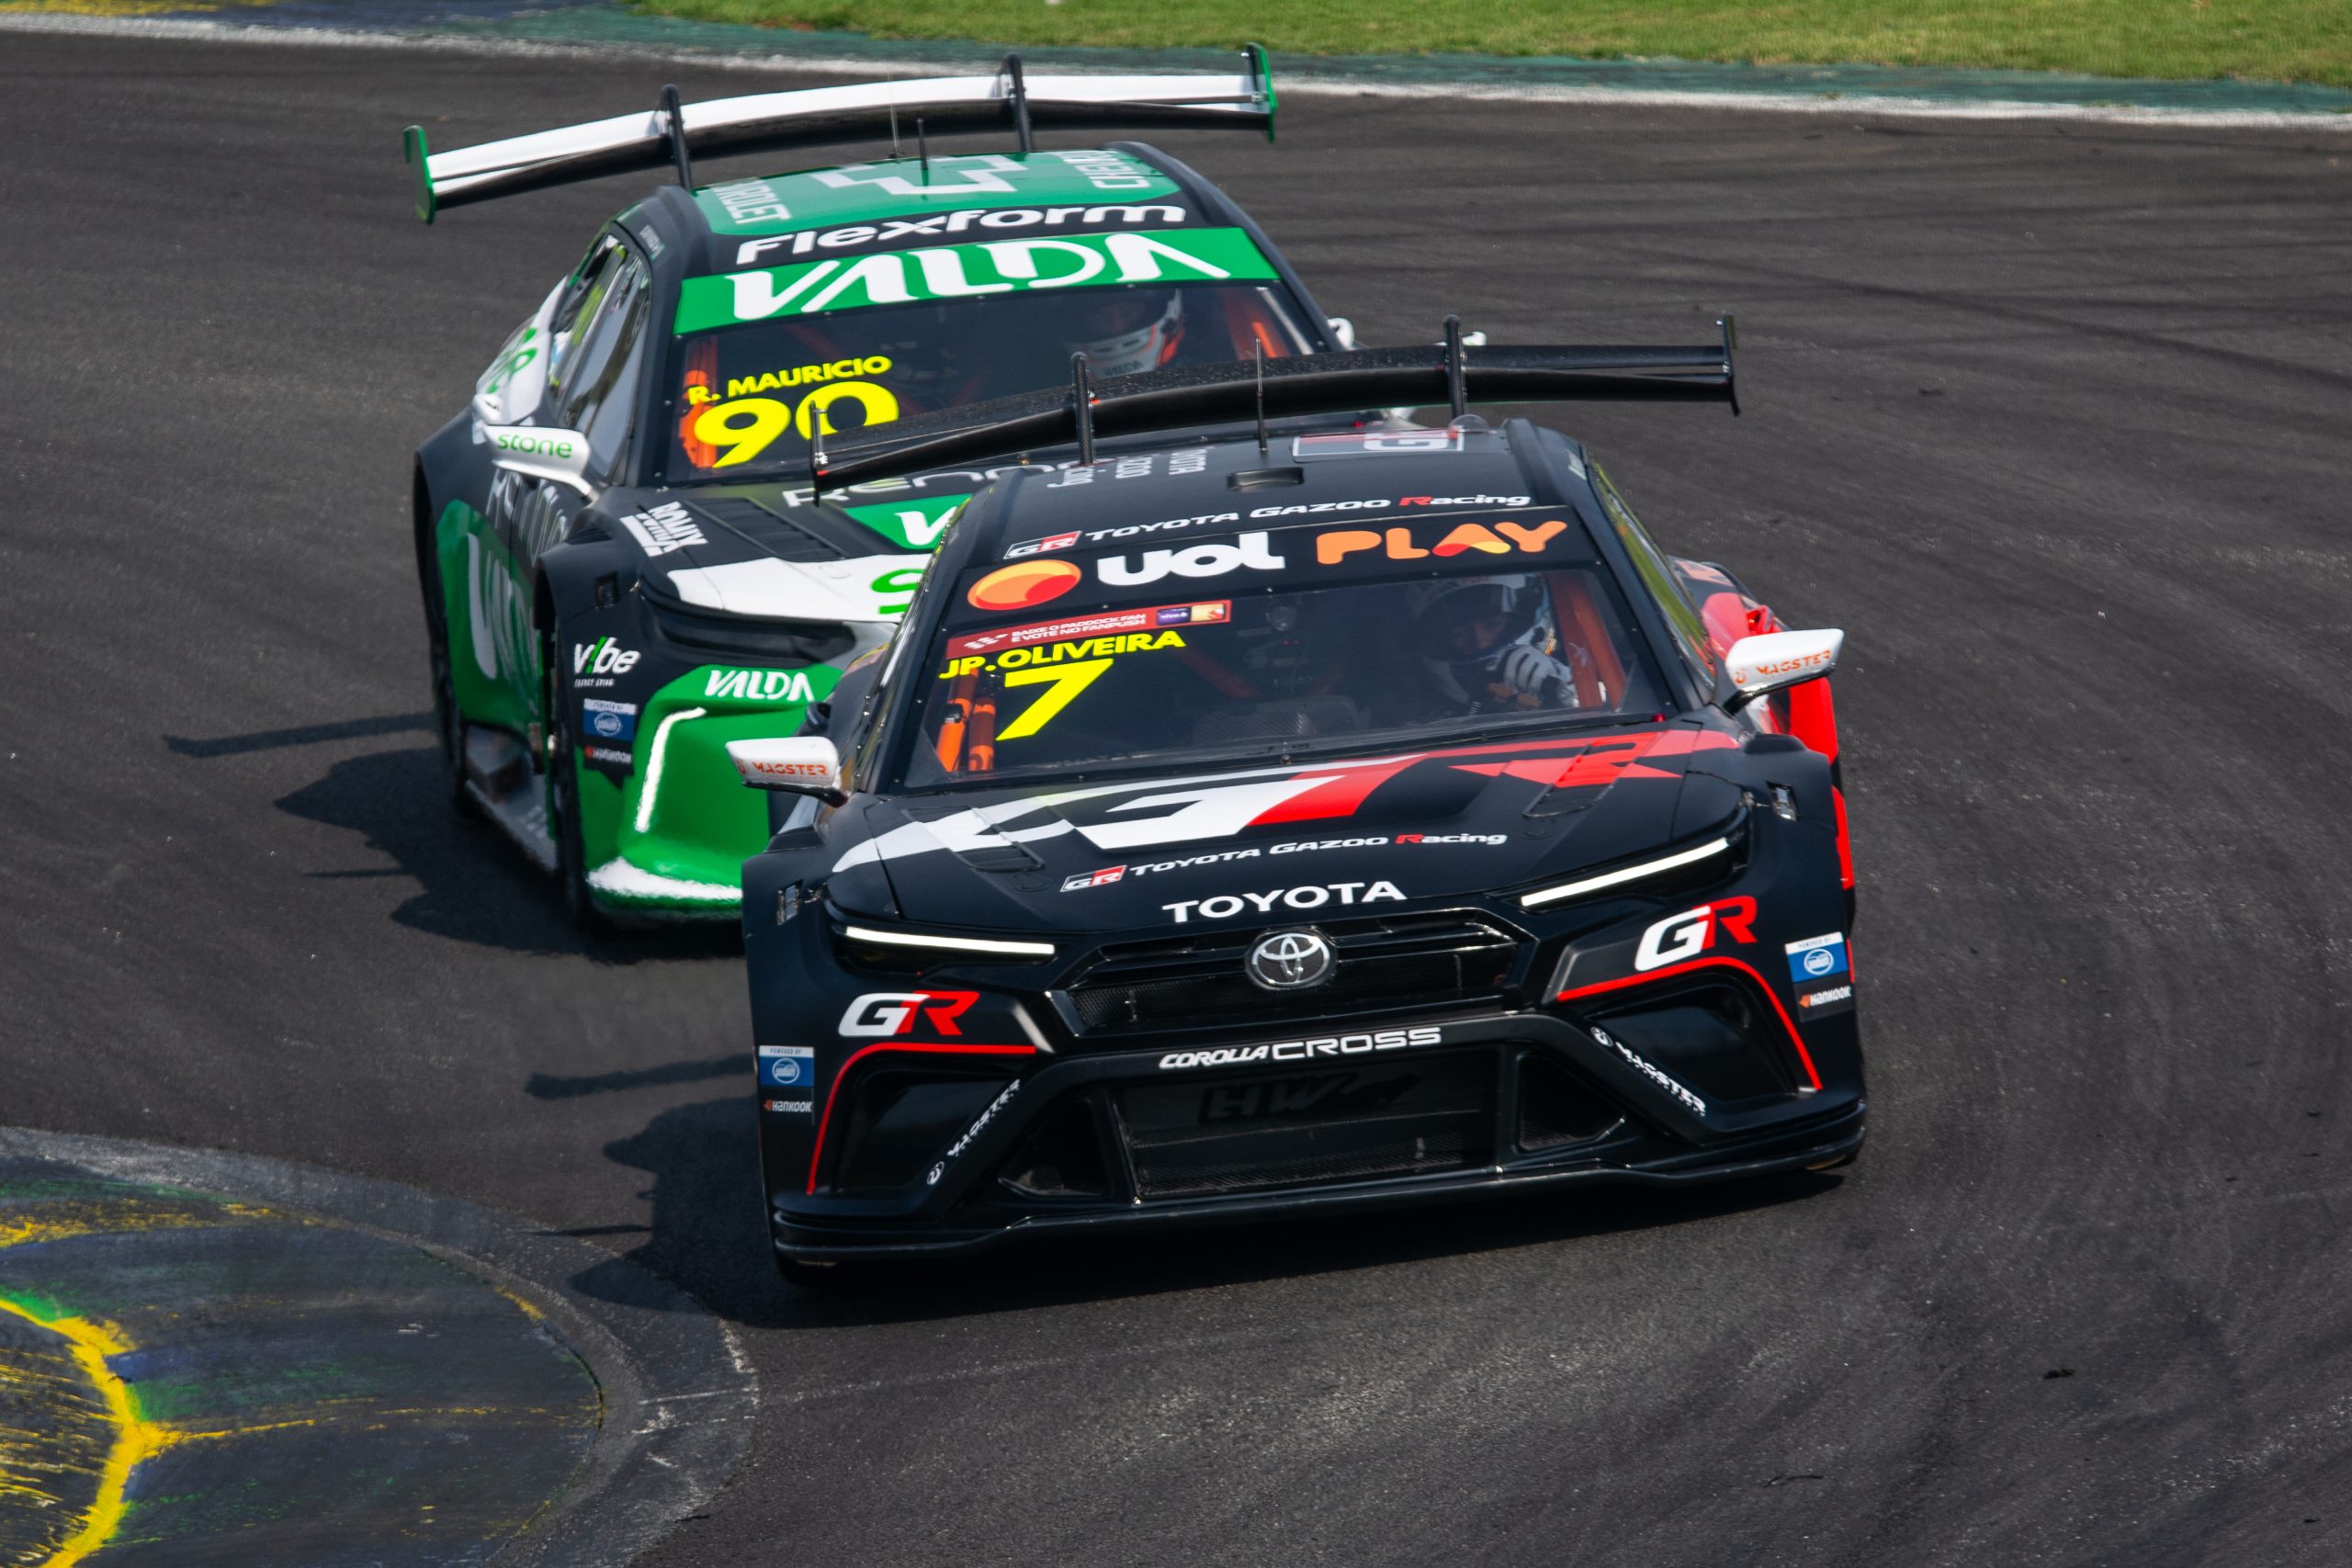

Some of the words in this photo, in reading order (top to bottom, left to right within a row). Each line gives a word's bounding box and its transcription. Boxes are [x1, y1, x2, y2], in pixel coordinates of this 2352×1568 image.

[736, 204, 1186, 265] Flexform
[724, 231, 1230, 320] VALDA
[688, 385, 721, 405] R.
[728, 355, 892, 399] MAURICIO
[497, 434, 573, 459] stone
[694, 380, 899, 468] 90
[1086, 512, 1239, 541] TOYOTA
[1250, 499, 1391, 518] GAZOO
[1398, 494, 1532, 506] Racing
[1316, 521, 1567, 565] PLAY
[938, 631, 1186, 679] JP.OLIVEIRA
[1023, 631, 1059, 640] VOTE
[705, 670, 815, 701] VALDA
[997, 658, 1114, 741] 7
[1062, 868, 1124, 892] GR
[1130, 848, 1261, 875] TOYOTA
[1269, 837, 1388, 854] GAZOO
[1396, 833, 1507, 845] Racing
[1162, 881, 1408, 923] TOYOTA
[1634, 895, 1758, 971] GR
[838, 990, 979, 1036] GR
[1159, 1045, 1270, 1069] COROLLA
[1272, 1027, 1441, 1060] CROSS
